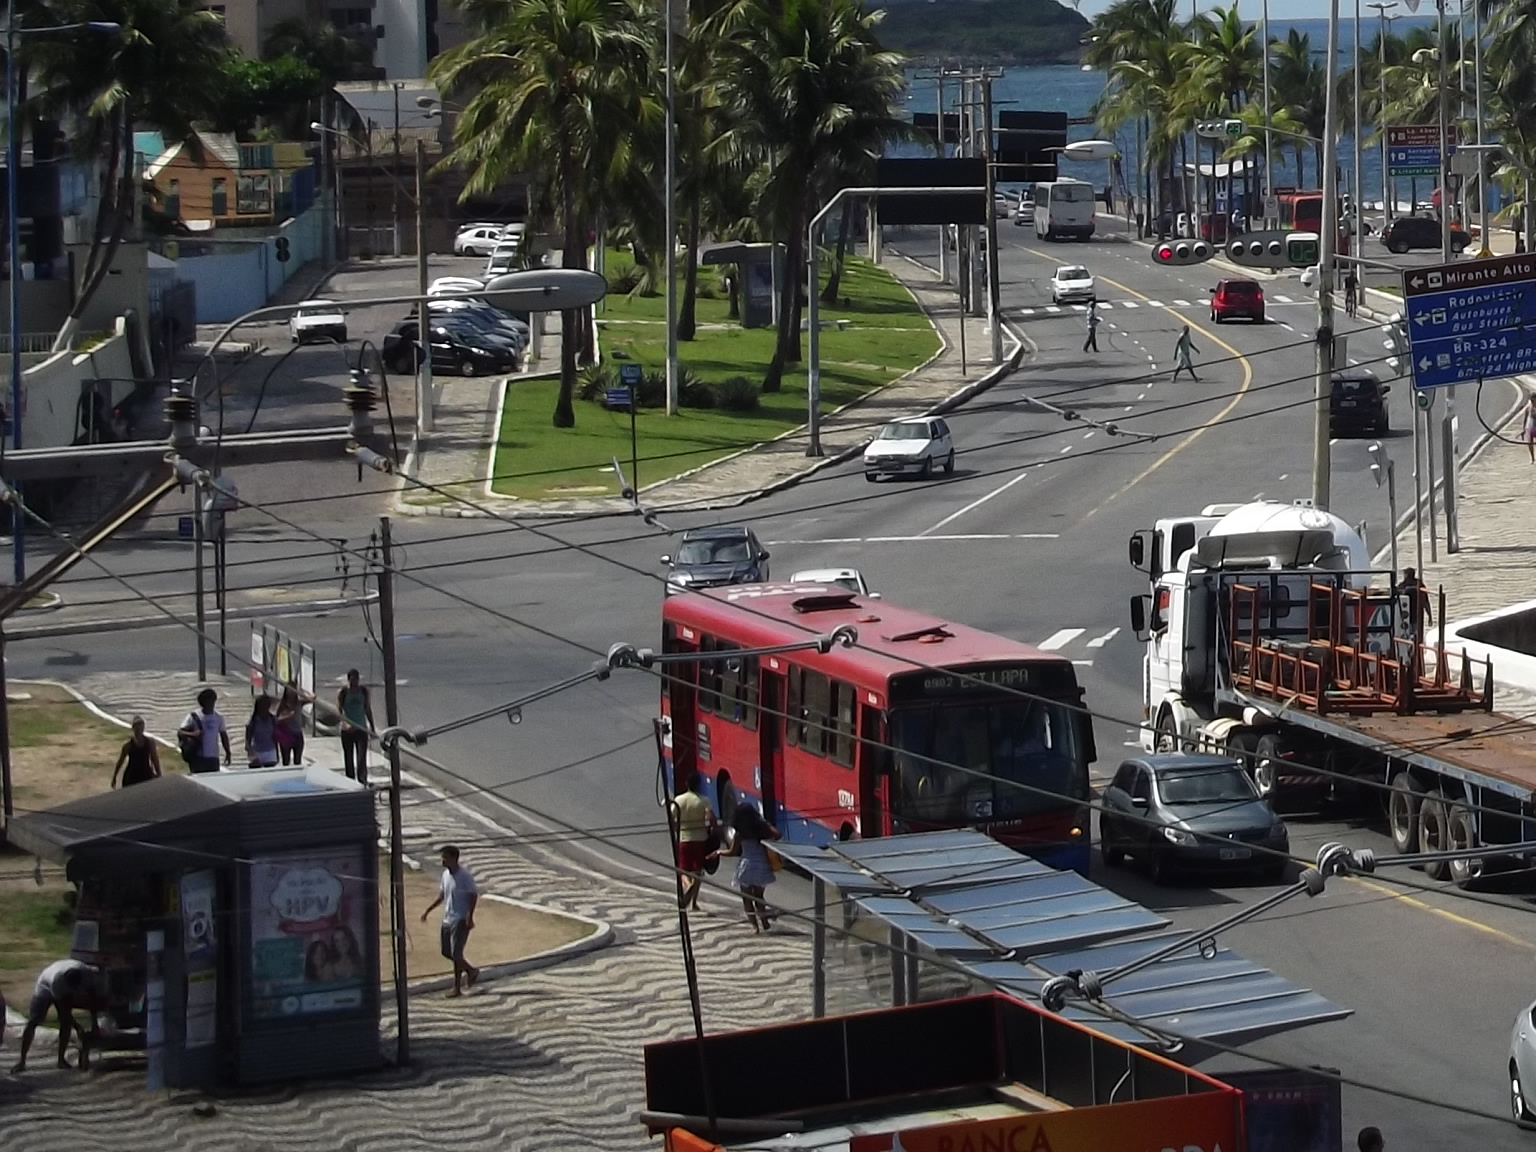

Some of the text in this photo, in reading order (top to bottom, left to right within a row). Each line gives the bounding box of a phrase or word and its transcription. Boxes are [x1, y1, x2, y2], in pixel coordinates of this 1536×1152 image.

[1446, 266, 1497, 284] Mirante
[1503, 263, 1531, 277] Alto
[1452, 305, 1512, 321] Autobuses
[1452, 322, 1474, 332] Bus
[1453, 335, 1508, 354] BR-324
[1456, 352, 1512, 367] Cetera
[286, 895, 329, 916] HPV
[938, 1121, 1054, 1152] BANCA
